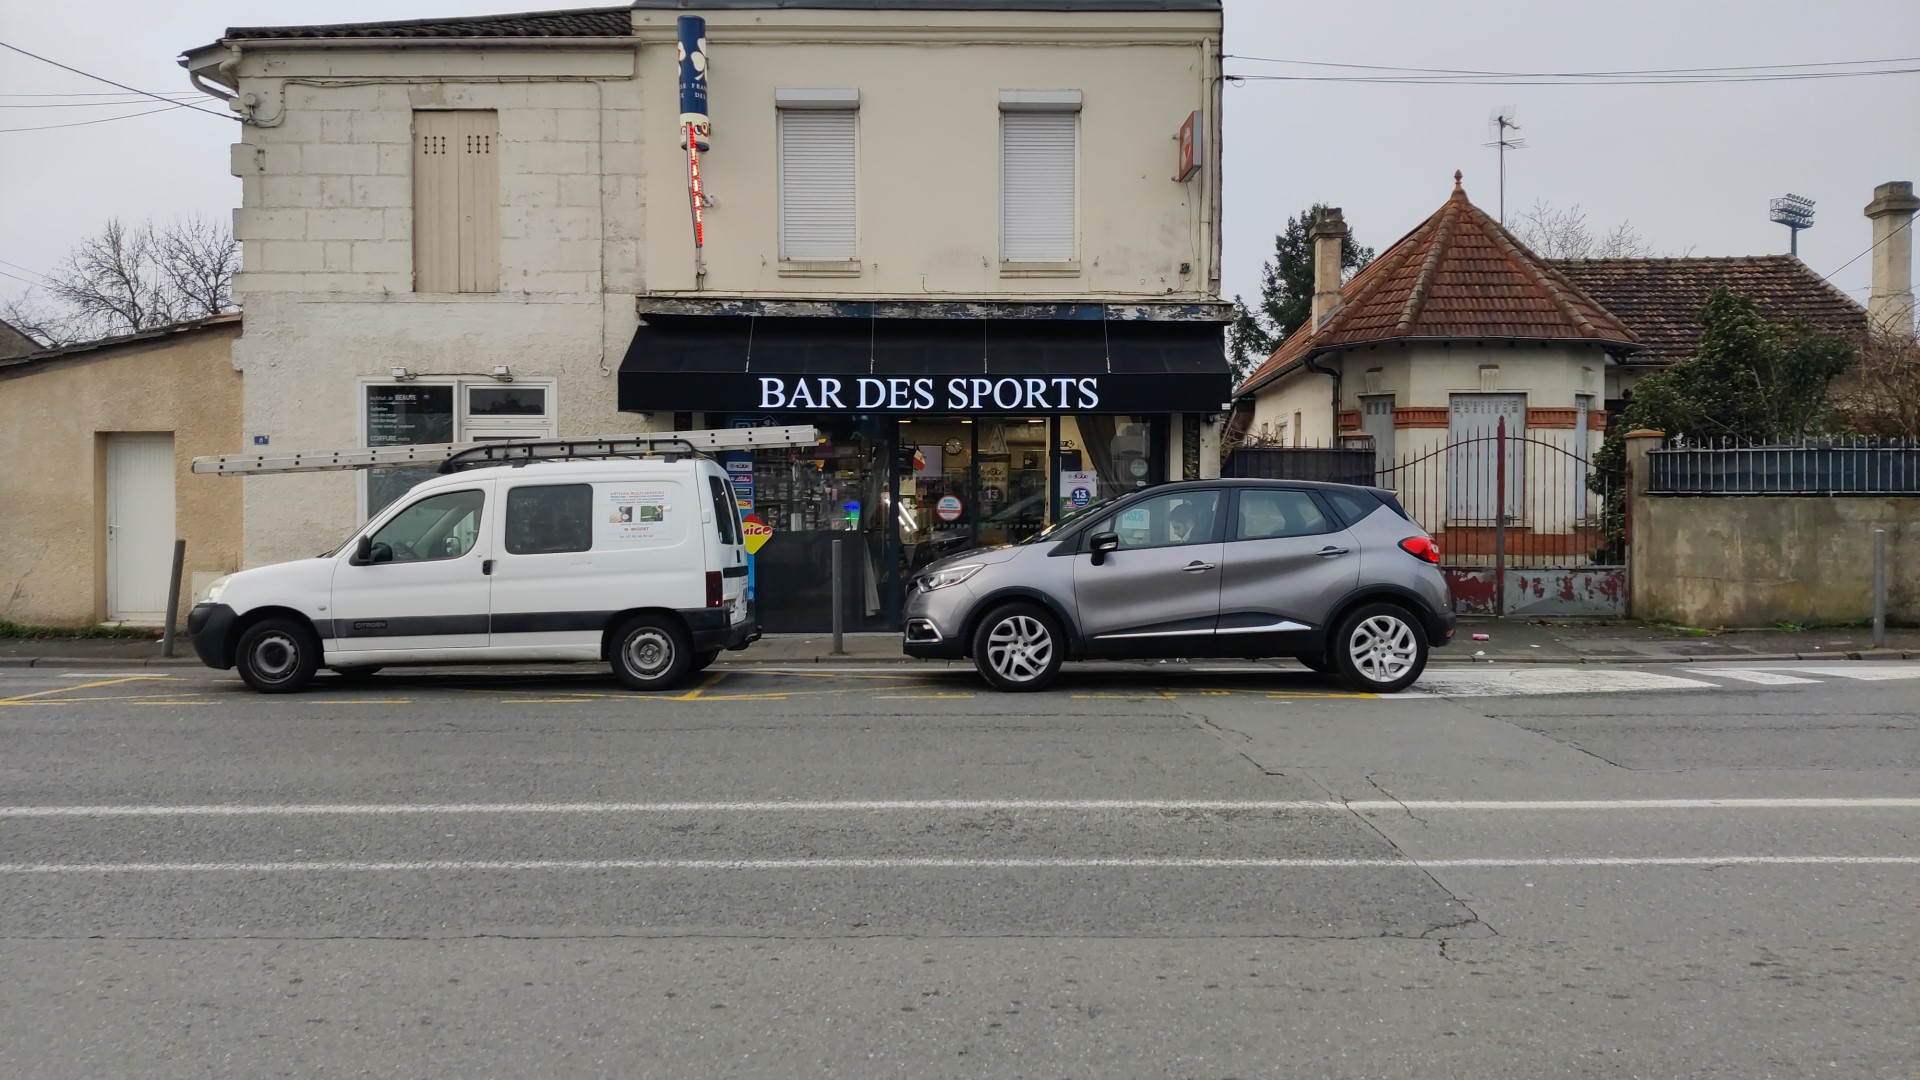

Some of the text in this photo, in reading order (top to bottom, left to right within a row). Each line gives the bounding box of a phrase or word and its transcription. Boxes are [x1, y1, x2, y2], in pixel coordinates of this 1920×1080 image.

[758, 376, 1100, 410] BAR DES SPORTS
[1074, 489, 1087, 499] 13
